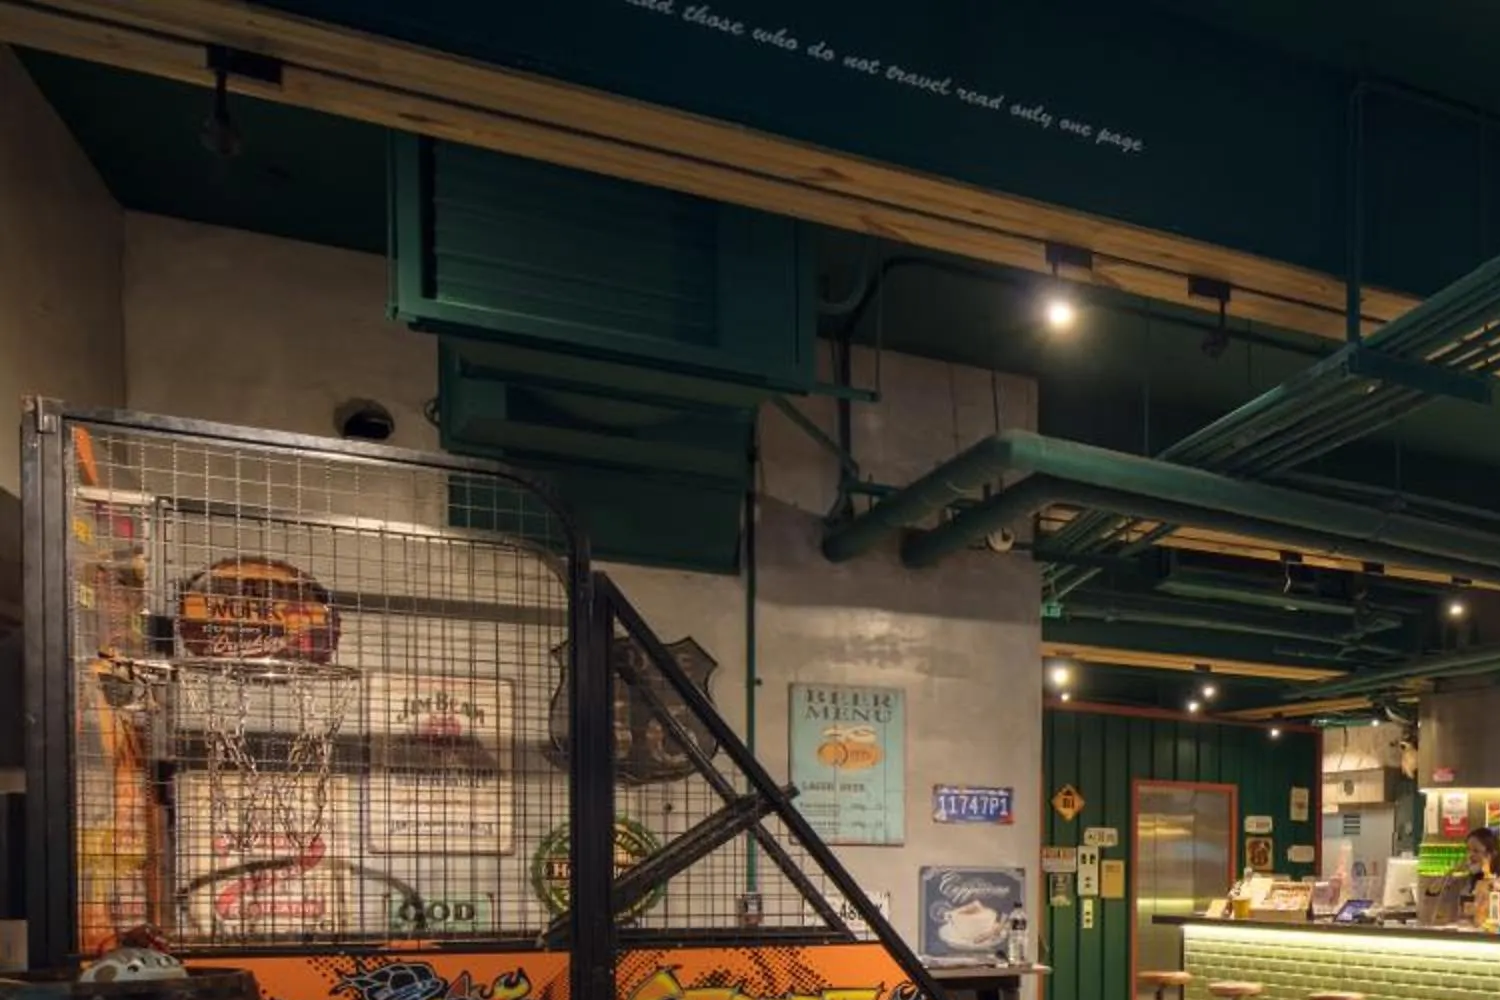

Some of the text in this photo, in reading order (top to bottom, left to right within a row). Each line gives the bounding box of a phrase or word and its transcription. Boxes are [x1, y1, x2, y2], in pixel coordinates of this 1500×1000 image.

[682, 5, 744, 36] those
[752, 28, 799, 50] who
[807, 41, 835, 61] do
[843, 55, 881, 75] not
[885, 64, 952, 95] travel
[956, 86, 1004, 110] read
[1010, 104, 1052, 128] only
[1059, 117, 1093, 137] one
[1095, 127, 1144, 152] page
[806, 688, 891, 707] BEER
[805, 706, 893, 723] MENU
